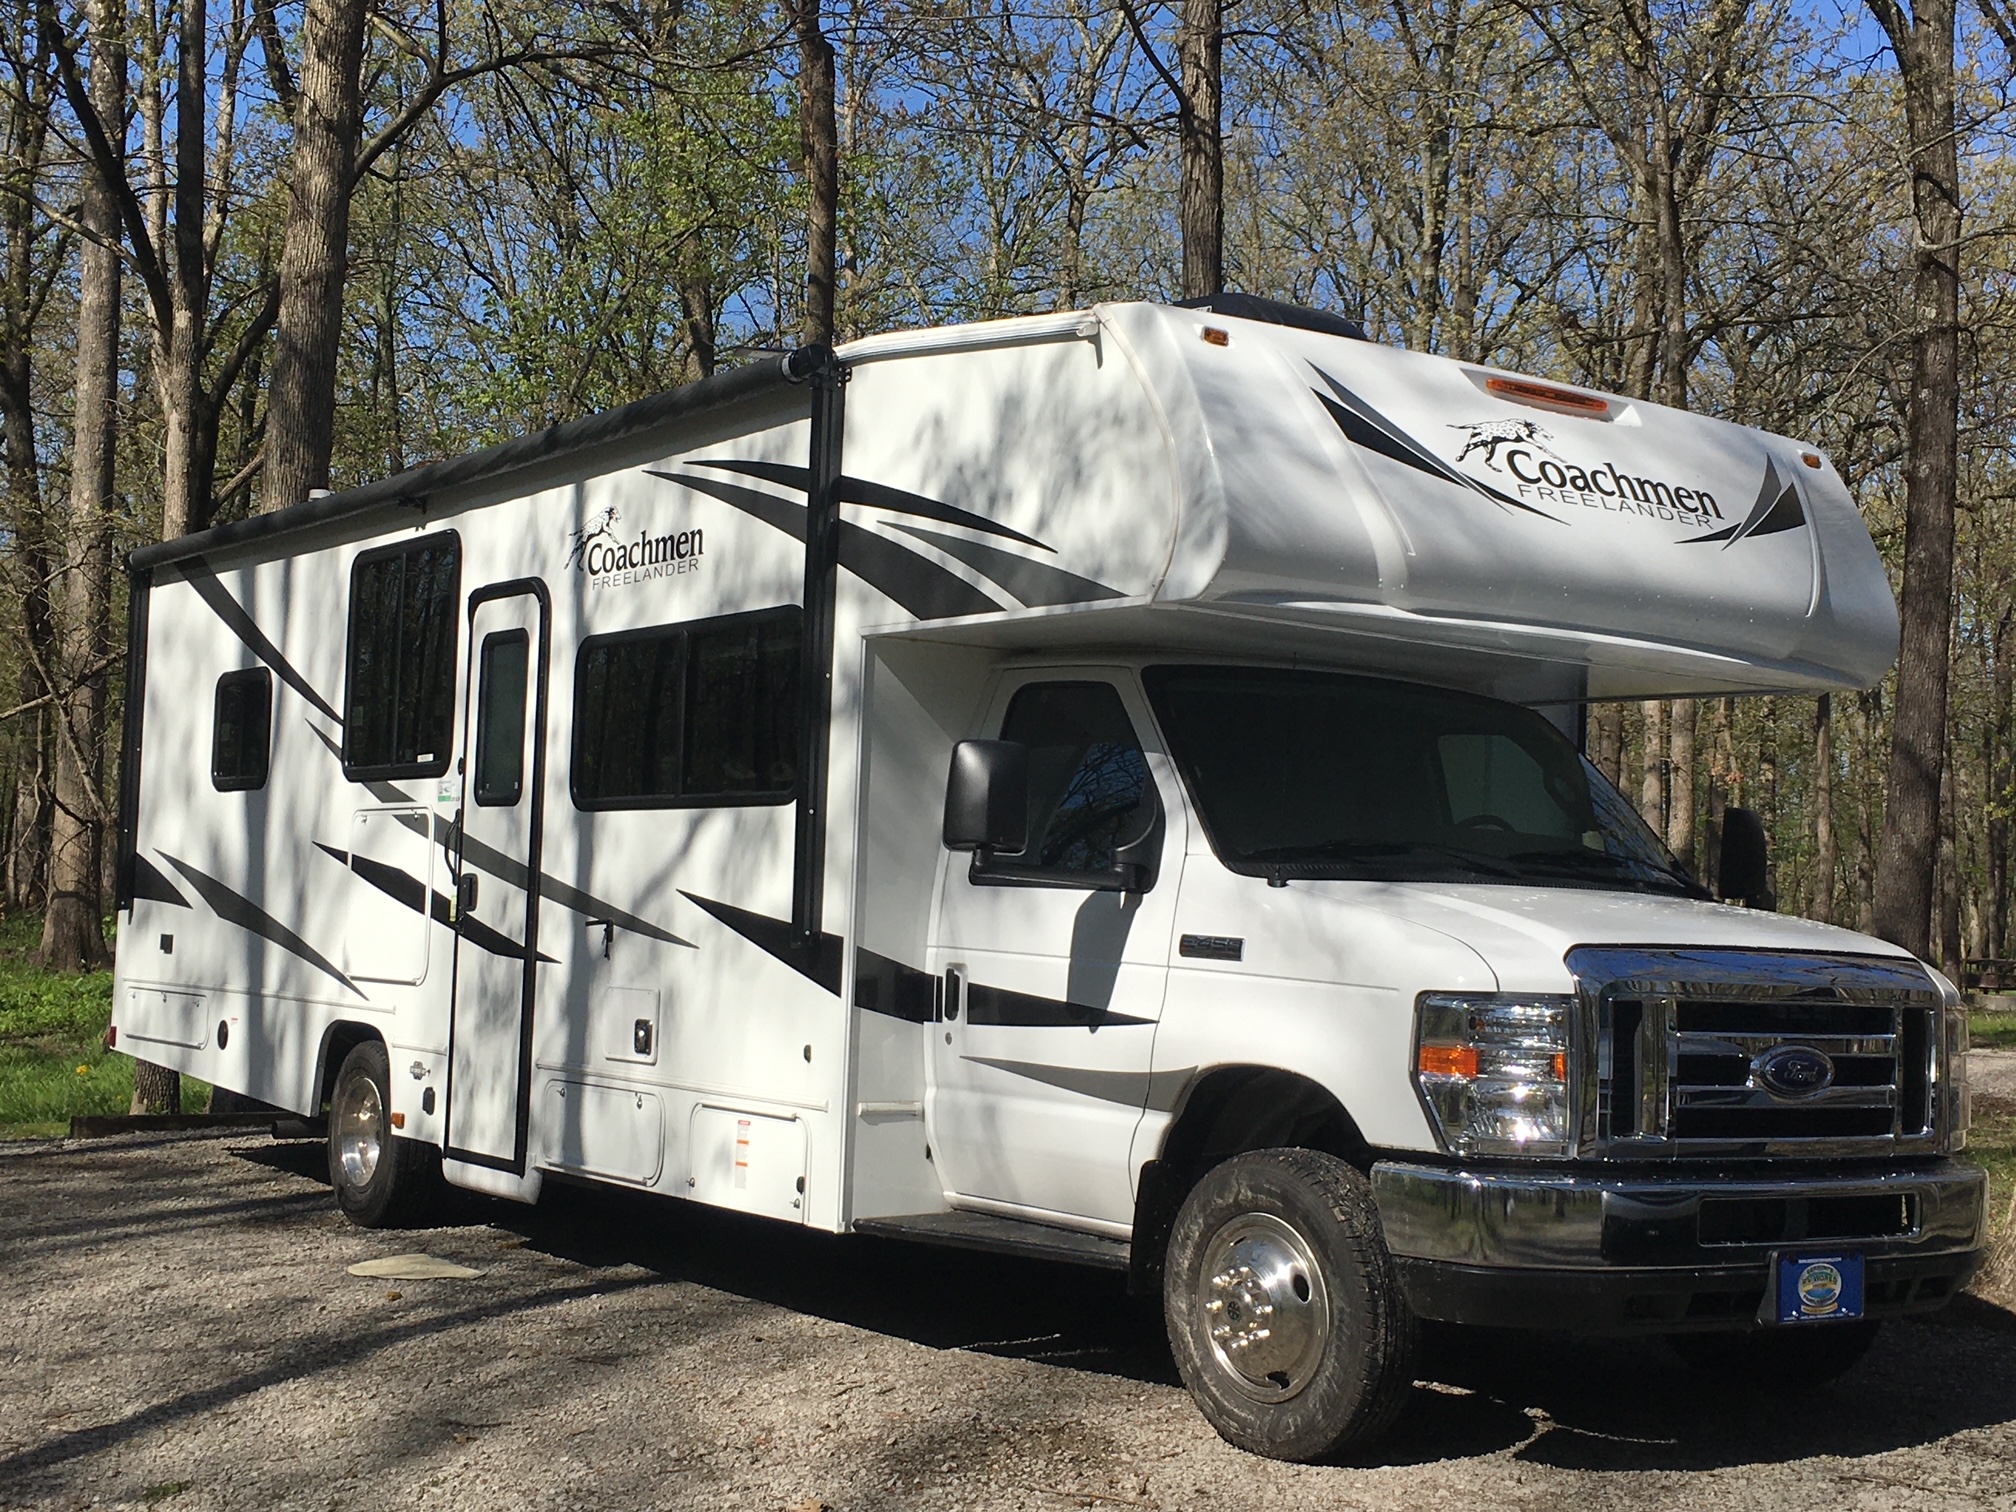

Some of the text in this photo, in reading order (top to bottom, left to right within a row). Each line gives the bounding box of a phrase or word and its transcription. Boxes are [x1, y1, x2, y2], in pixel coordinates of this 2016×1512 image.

[1506, 450, 1725, 520] Coachmen
[1517, 484, 1714, 530] FREELANDER
[587, 528, 704, 576] Coachmen
[592, 558, 699, 591] FREELANDER
[1784, 1060, 1818, 1082] Ford
